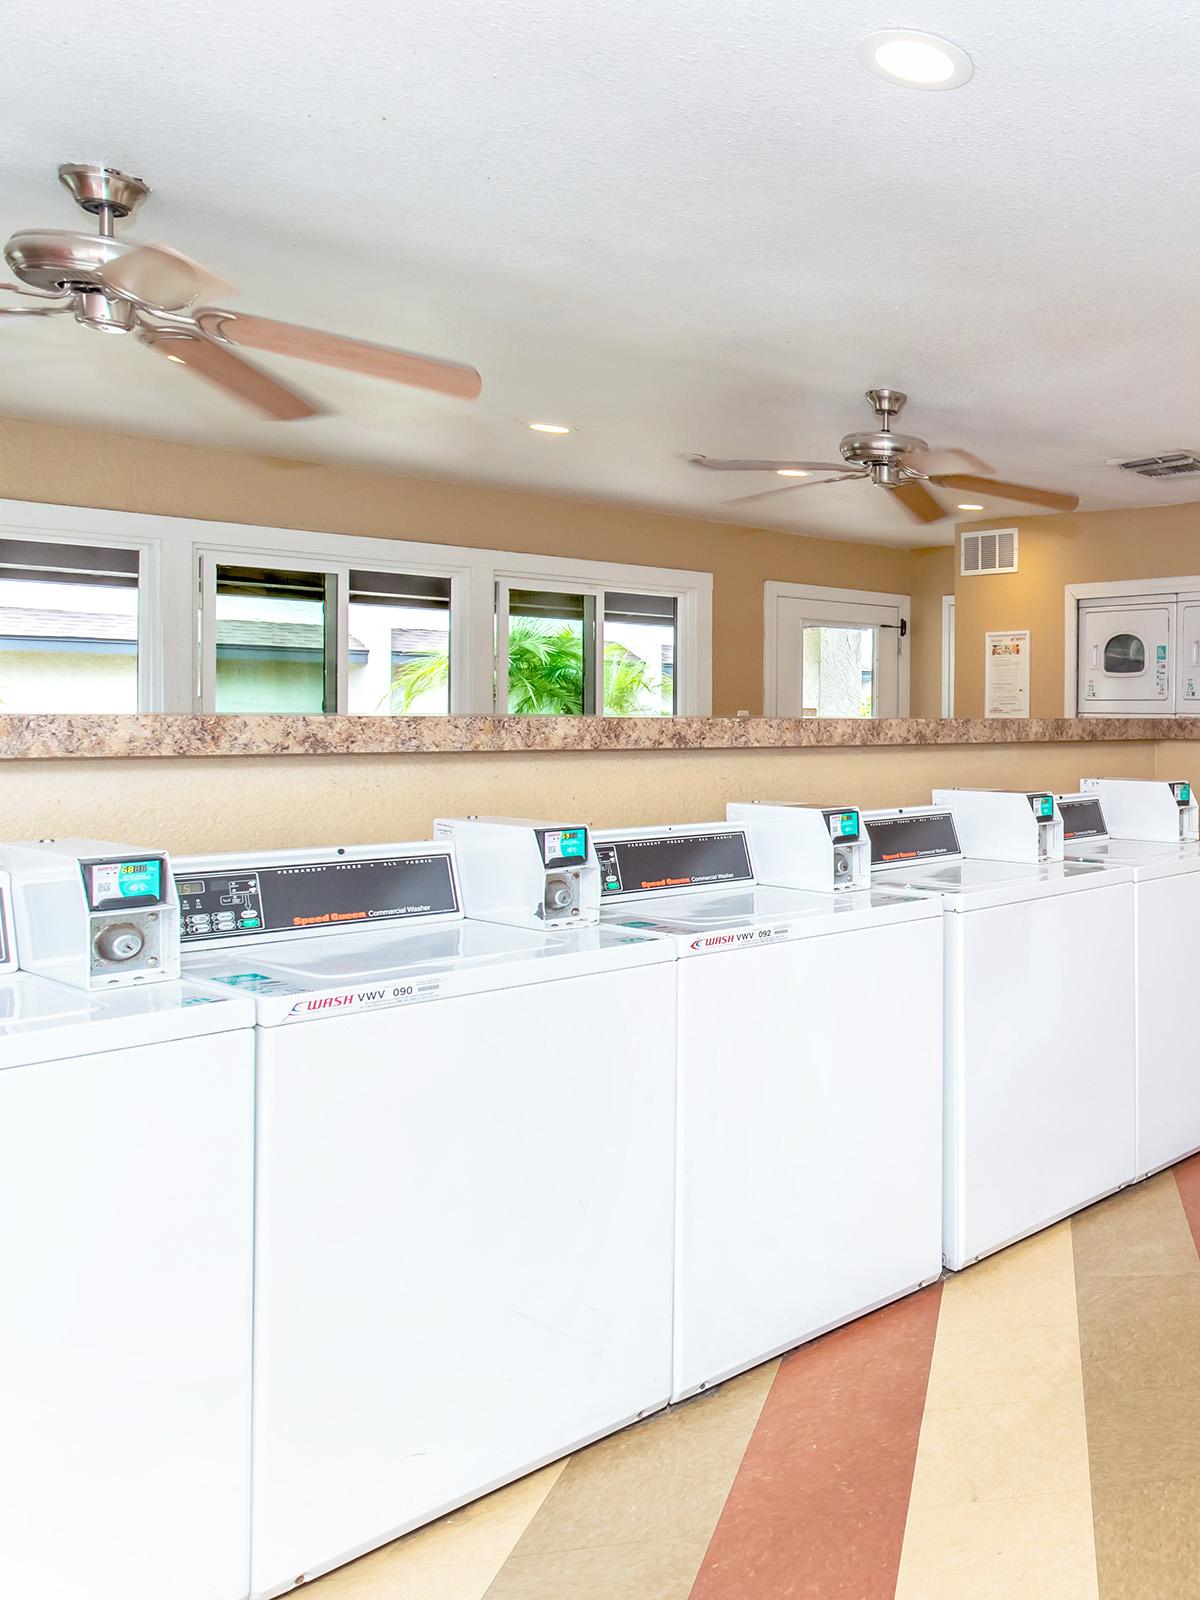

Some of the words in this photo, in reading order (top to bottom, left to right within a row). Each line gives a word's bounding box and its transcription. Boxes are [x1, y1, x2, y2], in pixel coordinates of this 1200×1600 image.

[641, 879, 666, 889] Speed
[691, 874, 718, 883] Commercial
[292, 913, 330, 926] Speed
[330, 911, 367, 922] Queen
[368, 906, 407, 917] Commercial
[407, 904, 431, 913] Washer
[705, 934, 735, 946] WASH
[736, 932, 755, 941] VWV
[758, 929, 772, 938] 092
[307, 994, 354, 1011] WASH
[357, 989, 386, 1002] VWV
[393, 986, 413, 997] 090
